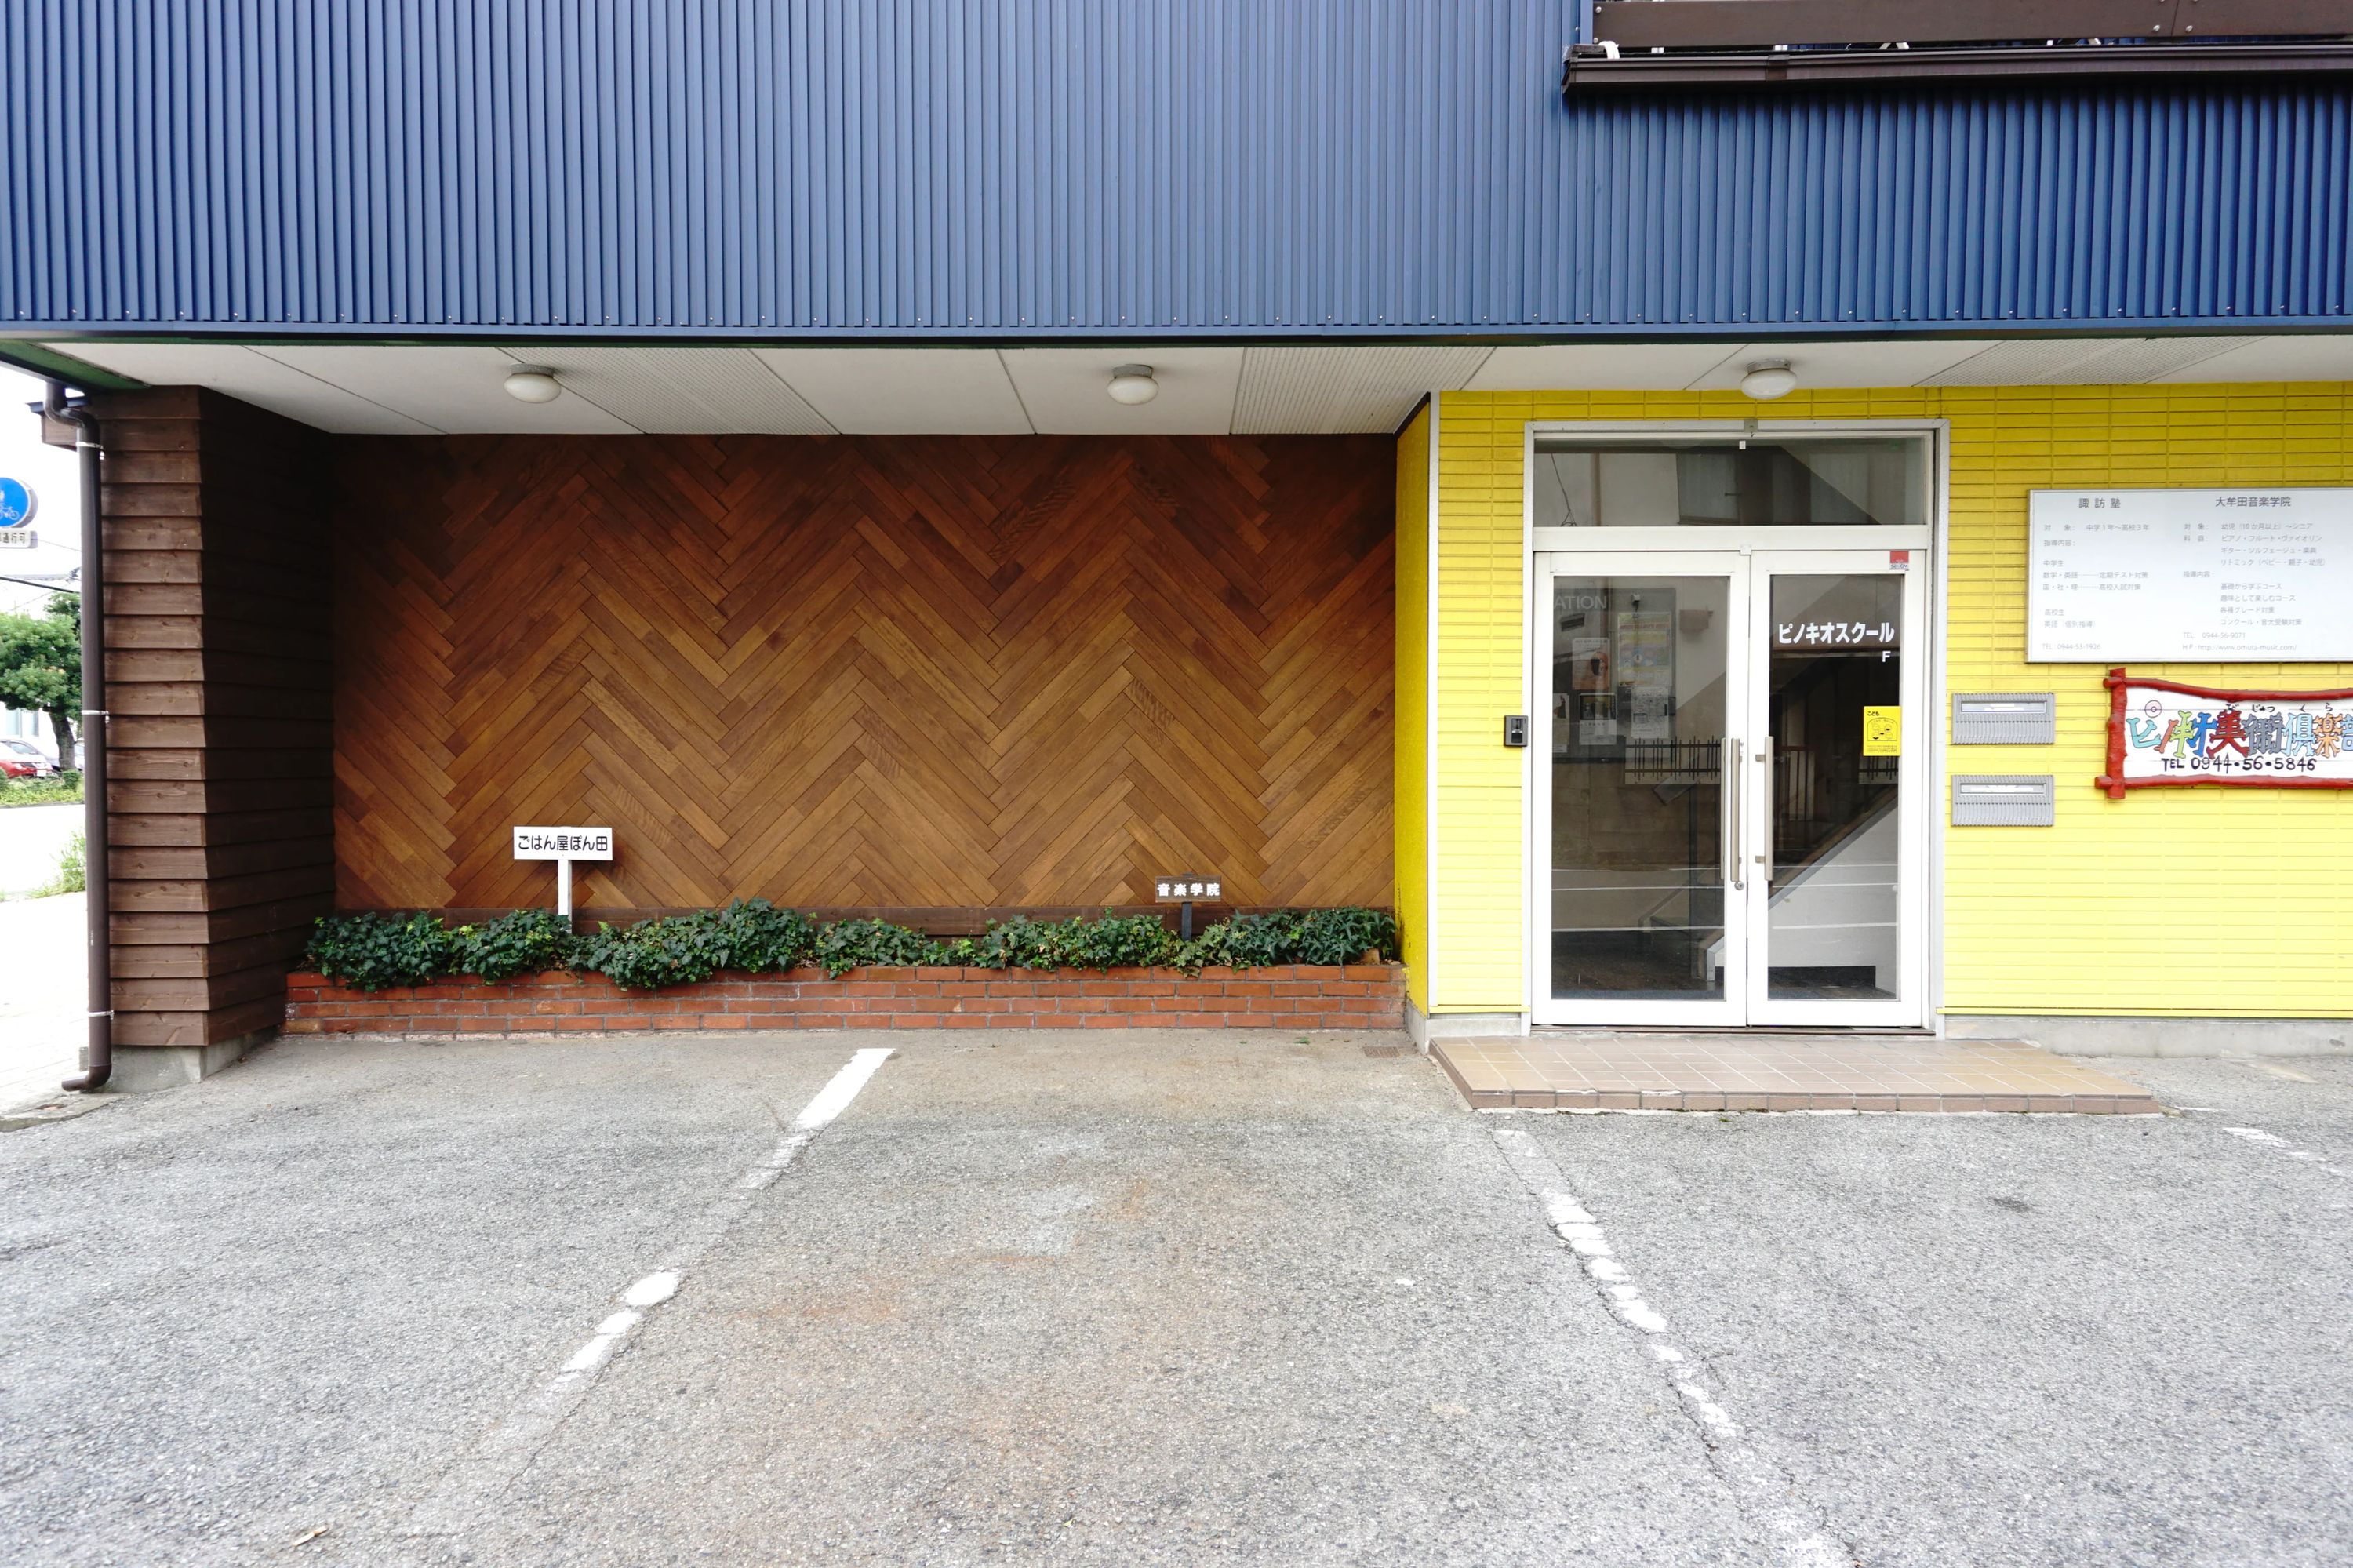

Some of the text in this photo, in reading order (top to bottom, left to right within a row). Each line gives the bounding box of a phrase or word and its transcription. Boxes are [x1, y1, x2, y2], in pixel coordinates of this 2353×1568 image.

[2078, 497, 2122, 509] 諏訪塾
[2215, 496, 2291, 508] 大牟田音楽学院
[1778, 622, 1895, 644] ピノキオスクール
[2161, 757, 2185, 770] TEL
[518, 835, 609, 852] ごはん屋ぽん田
[1157, 882, 1220, 897] 音楽学院
